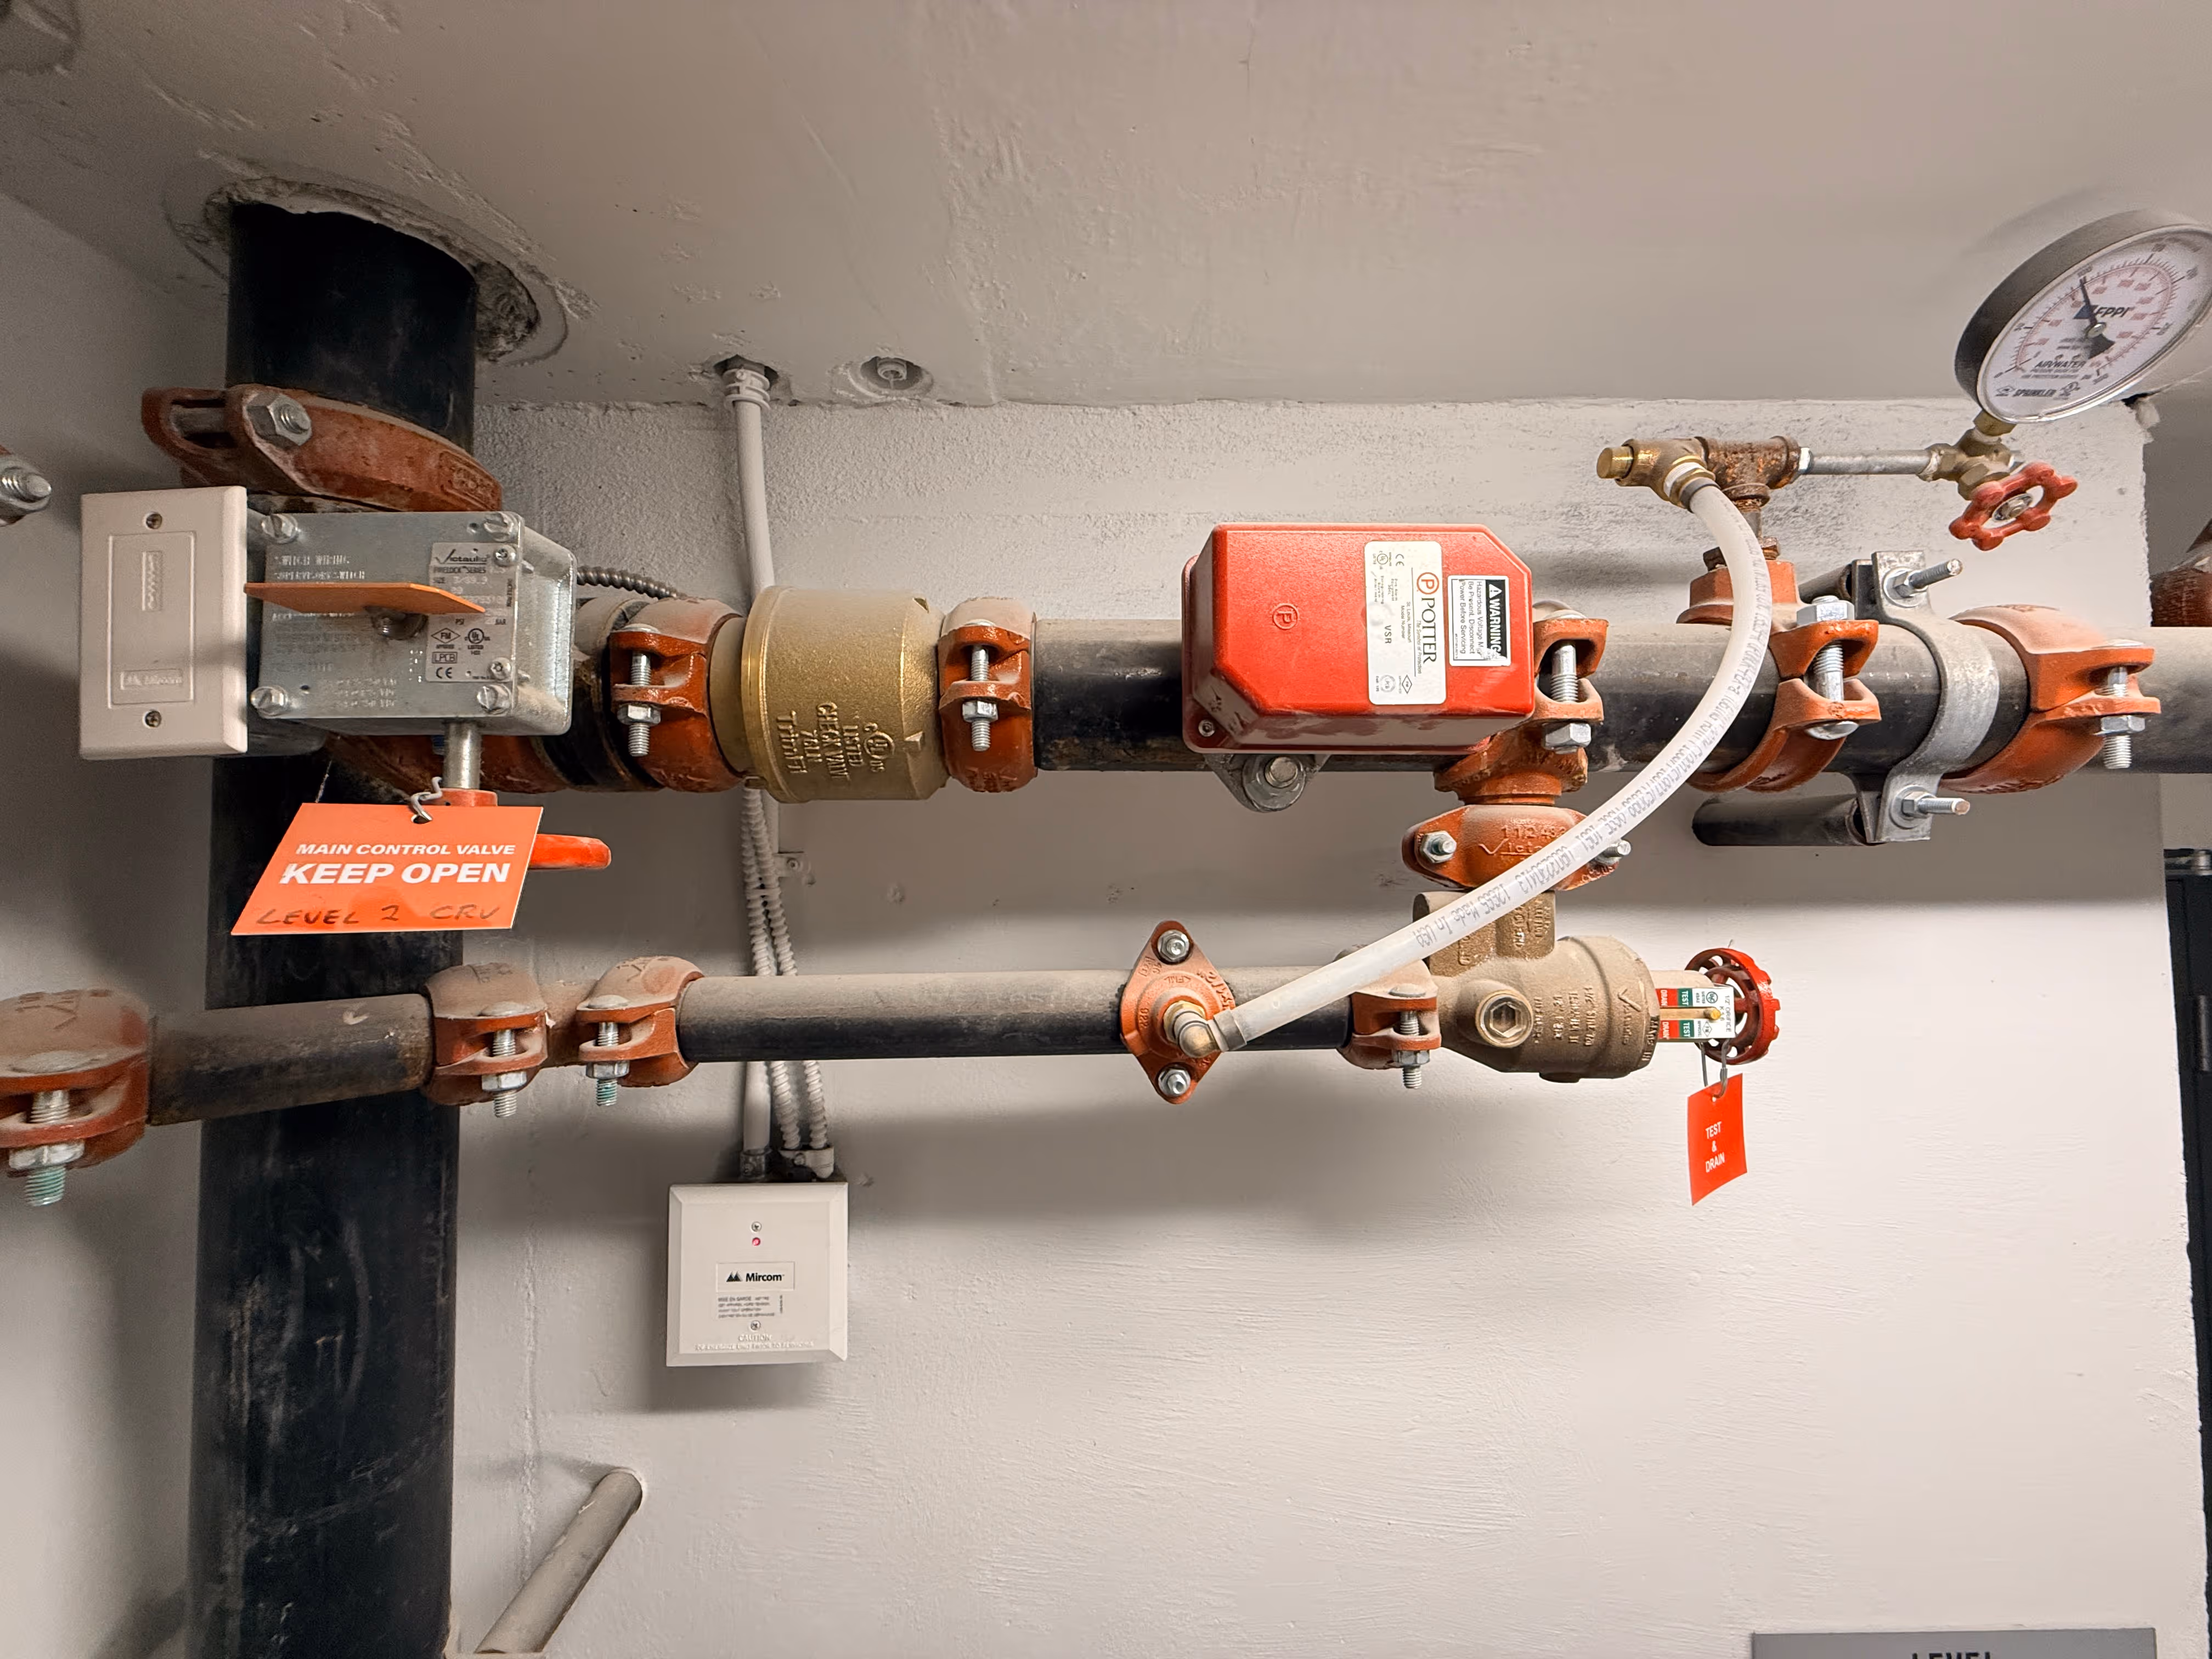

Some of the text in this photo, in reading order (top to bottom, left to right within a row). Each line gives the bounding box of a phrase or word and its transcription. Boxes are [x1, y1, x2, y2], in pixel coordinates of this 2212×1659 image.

[1468, 581, 1474, 590] Be
[1421, 597, 1437, 664] POTTER
[1489, 598, 1502, 654] WARNING
[816, 702, 842, 747] CHECK
[295, 843, 516, 855] MAIN CONTROL VALVE
[279, 862, 511, 884] KEEP OPEN
[256, 908, 359, 925] LEVEL
[381, 904, 400, 922] 2
[1451, 901, 1480, 927] Made
[1412, 924, 1436, 948] USA
[1705, 1121, 1723, 1139] TEST
[1712, 1140, 1717, 1153] &
[1705, 1152, 1725, 1173] DRAIN
[746, 1272, 782, 1282] Mircom
